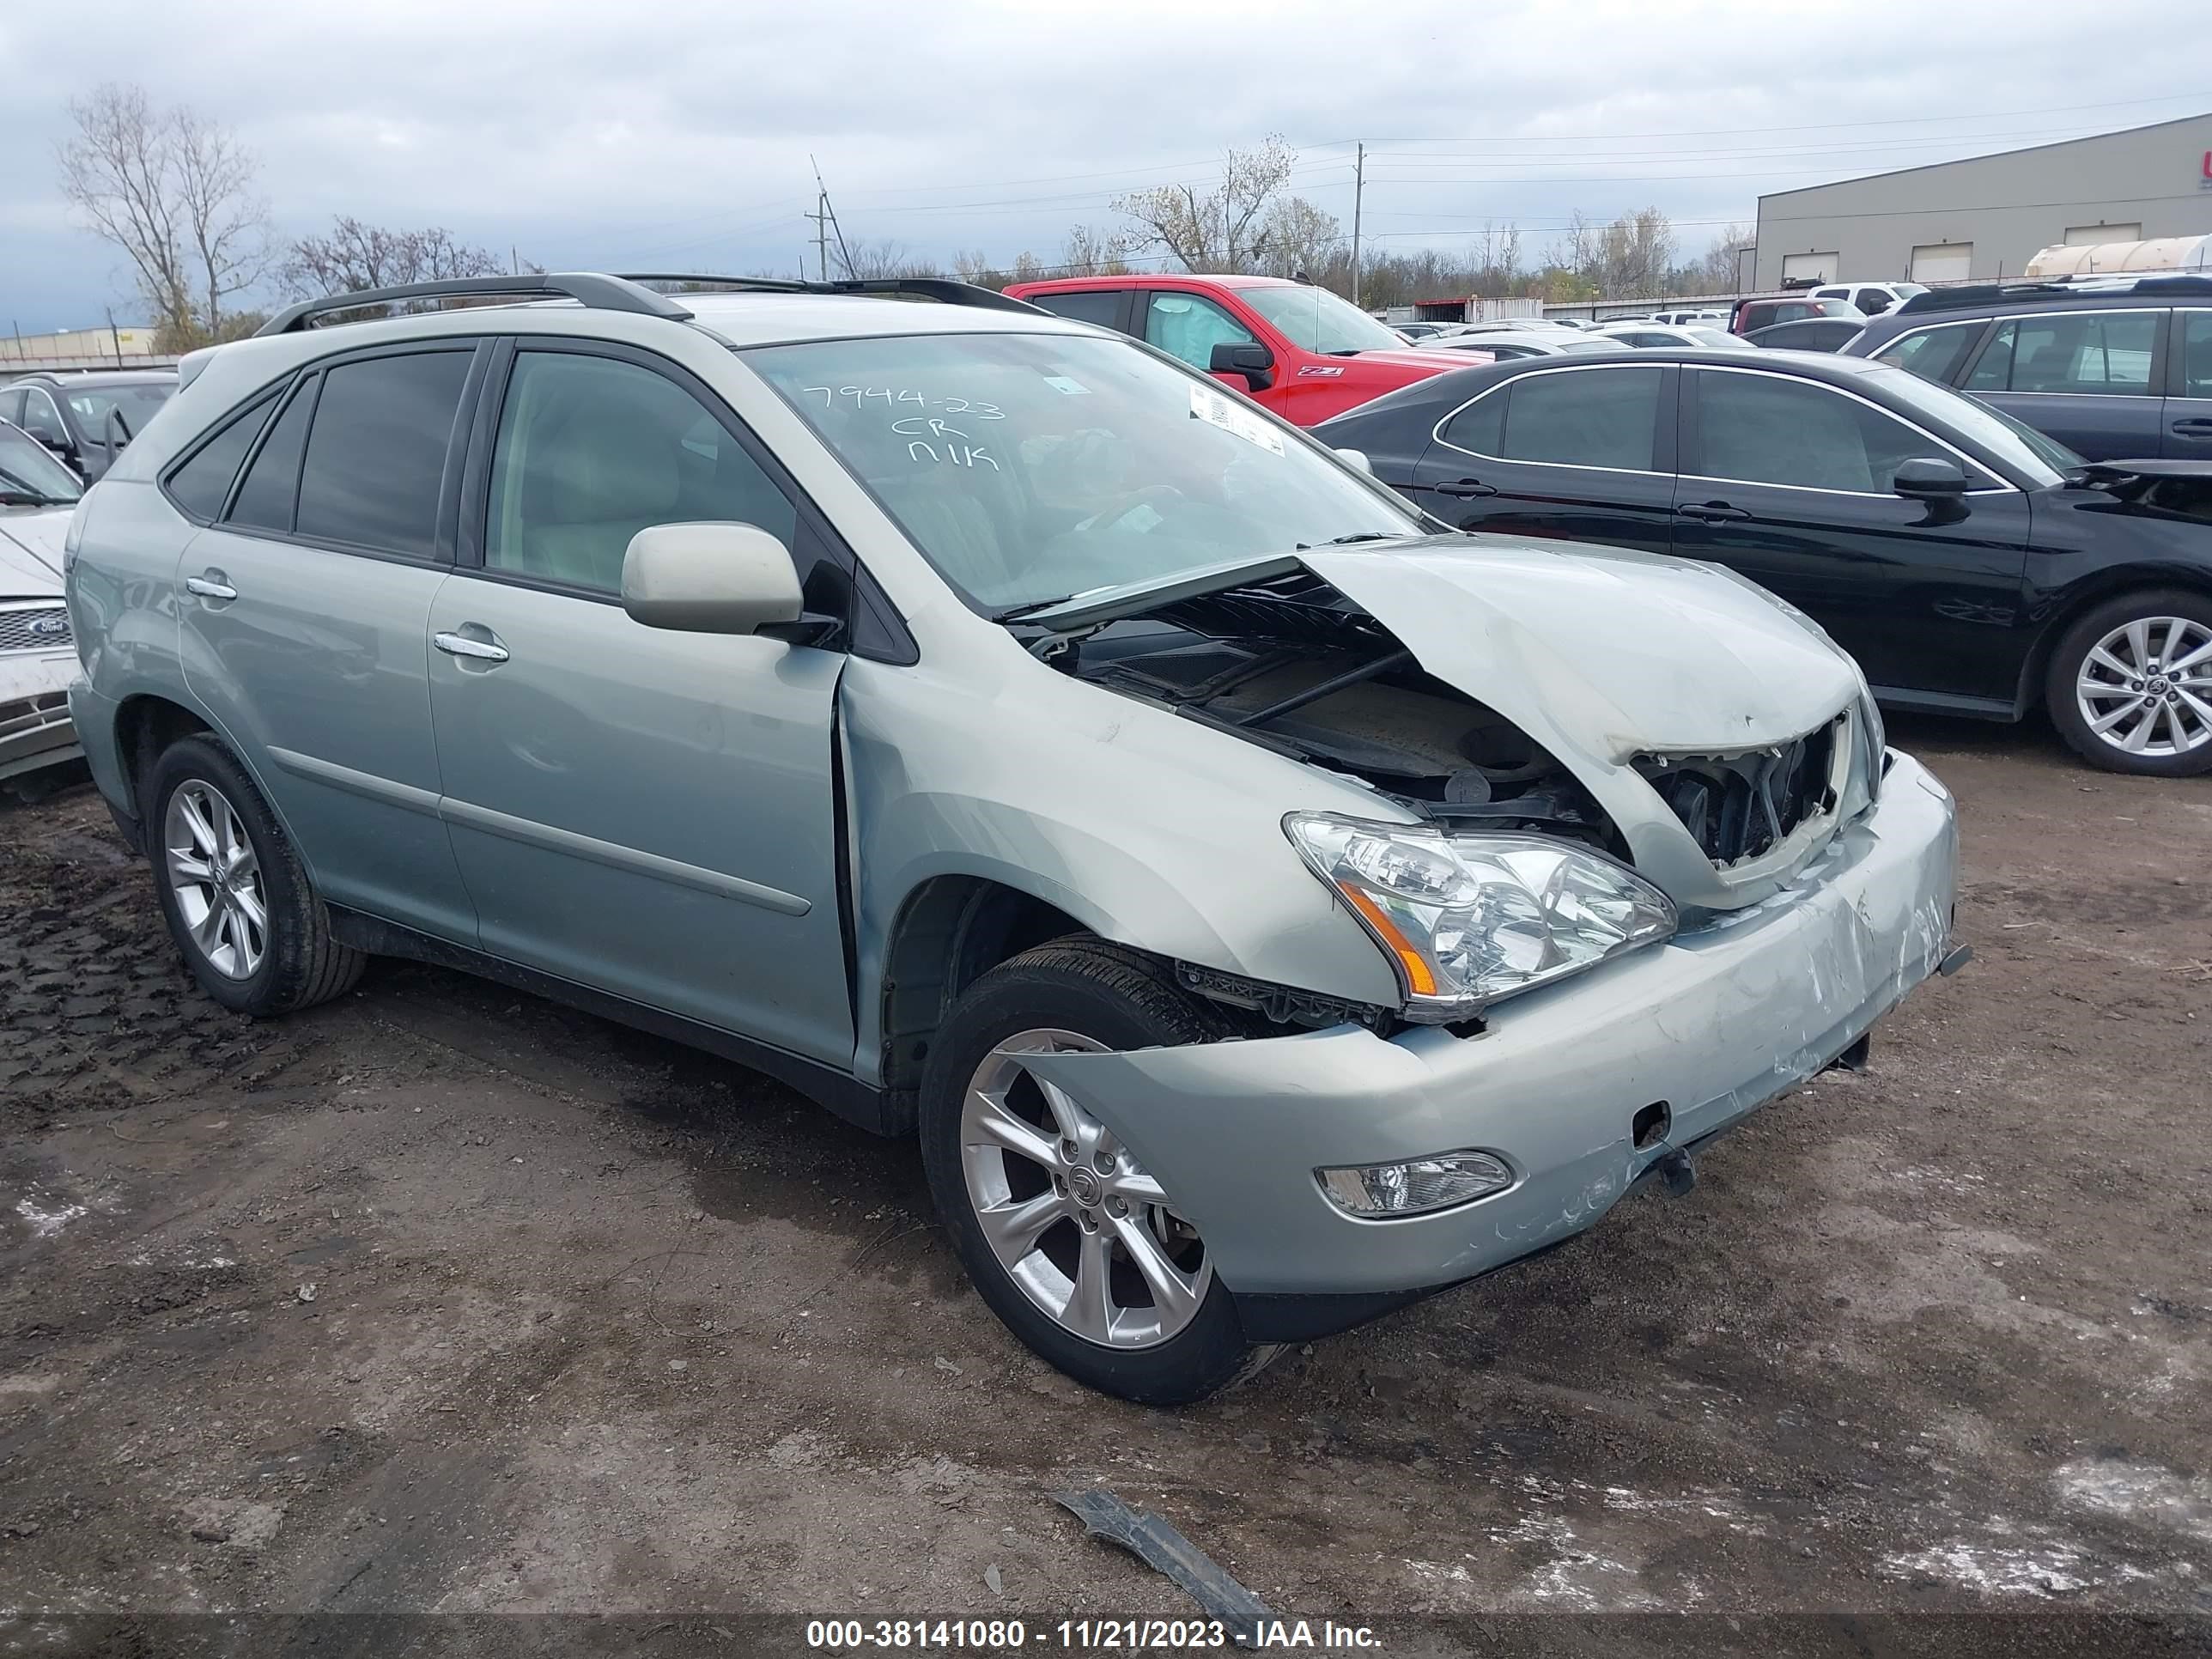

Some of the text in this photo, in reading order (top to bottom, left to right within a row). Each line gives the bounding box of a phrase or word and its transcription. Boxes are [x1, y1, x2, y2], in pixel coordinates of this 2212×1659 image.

[1297, 366, 1346, 377] Z71
[803, 386, 1006, 420] 7944-23
[891, 417, 969, 439] CR
